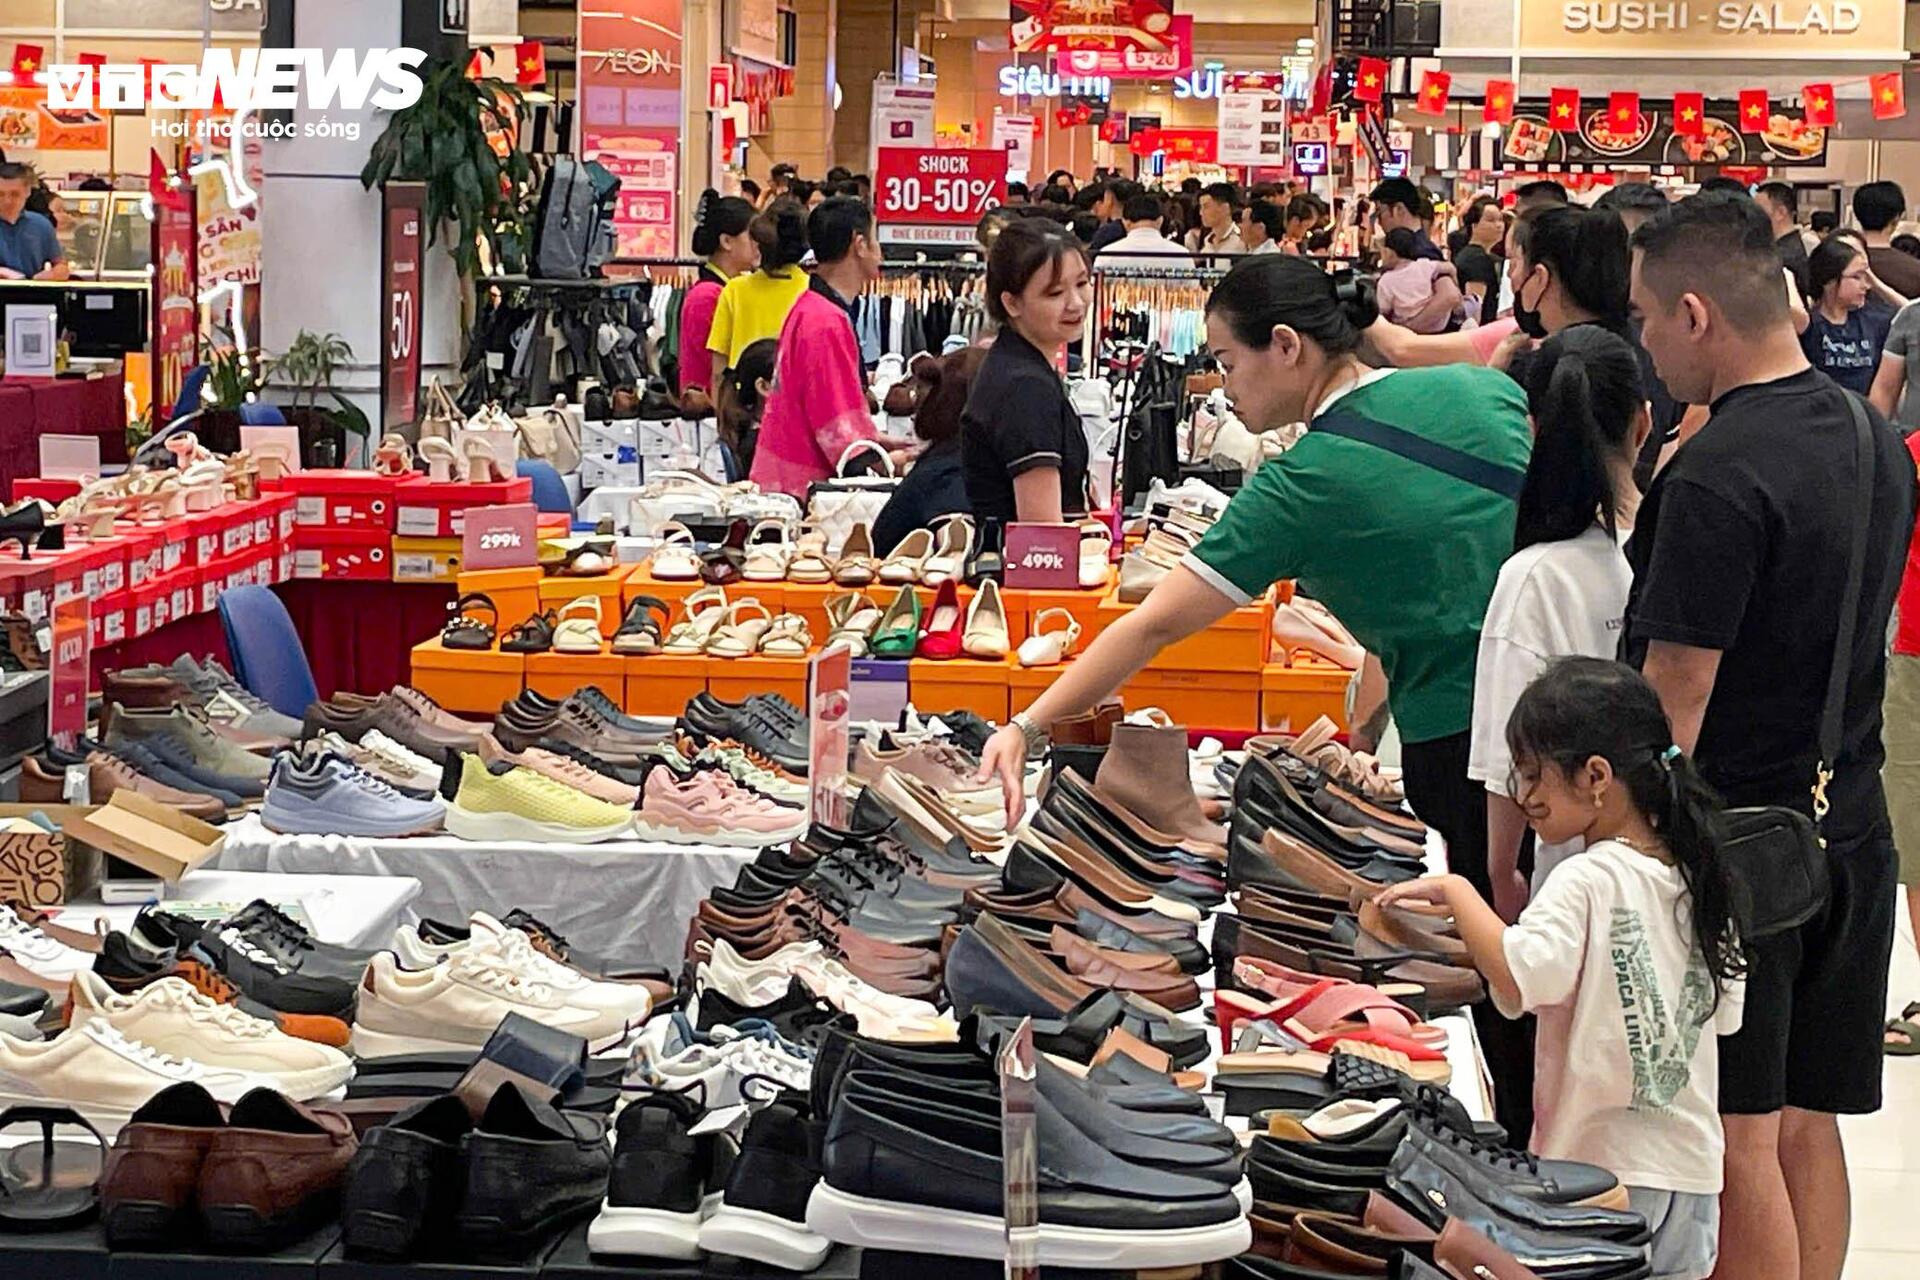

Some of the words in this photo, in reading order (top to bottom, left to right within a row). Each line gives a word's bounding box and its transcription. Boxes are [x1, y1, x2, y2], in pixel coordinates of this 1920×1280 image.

[1563, 1, 1690, 33] SUSHI
[1713, 1, 1863, 34] SALAD
[1000, 65, 1061, 97] Siêu
[1301, 126, 1321, 140] 43
[918, 155, 970, 174] SHOCK
[885, 177, 1001, 214] 30-50%
[391, 291, 413, 359] 50
[480, 533, 521, 549] 299k
[1022, 553, 1063, 569] 499k
[1611, 948, 1635, 1009] SPACA
